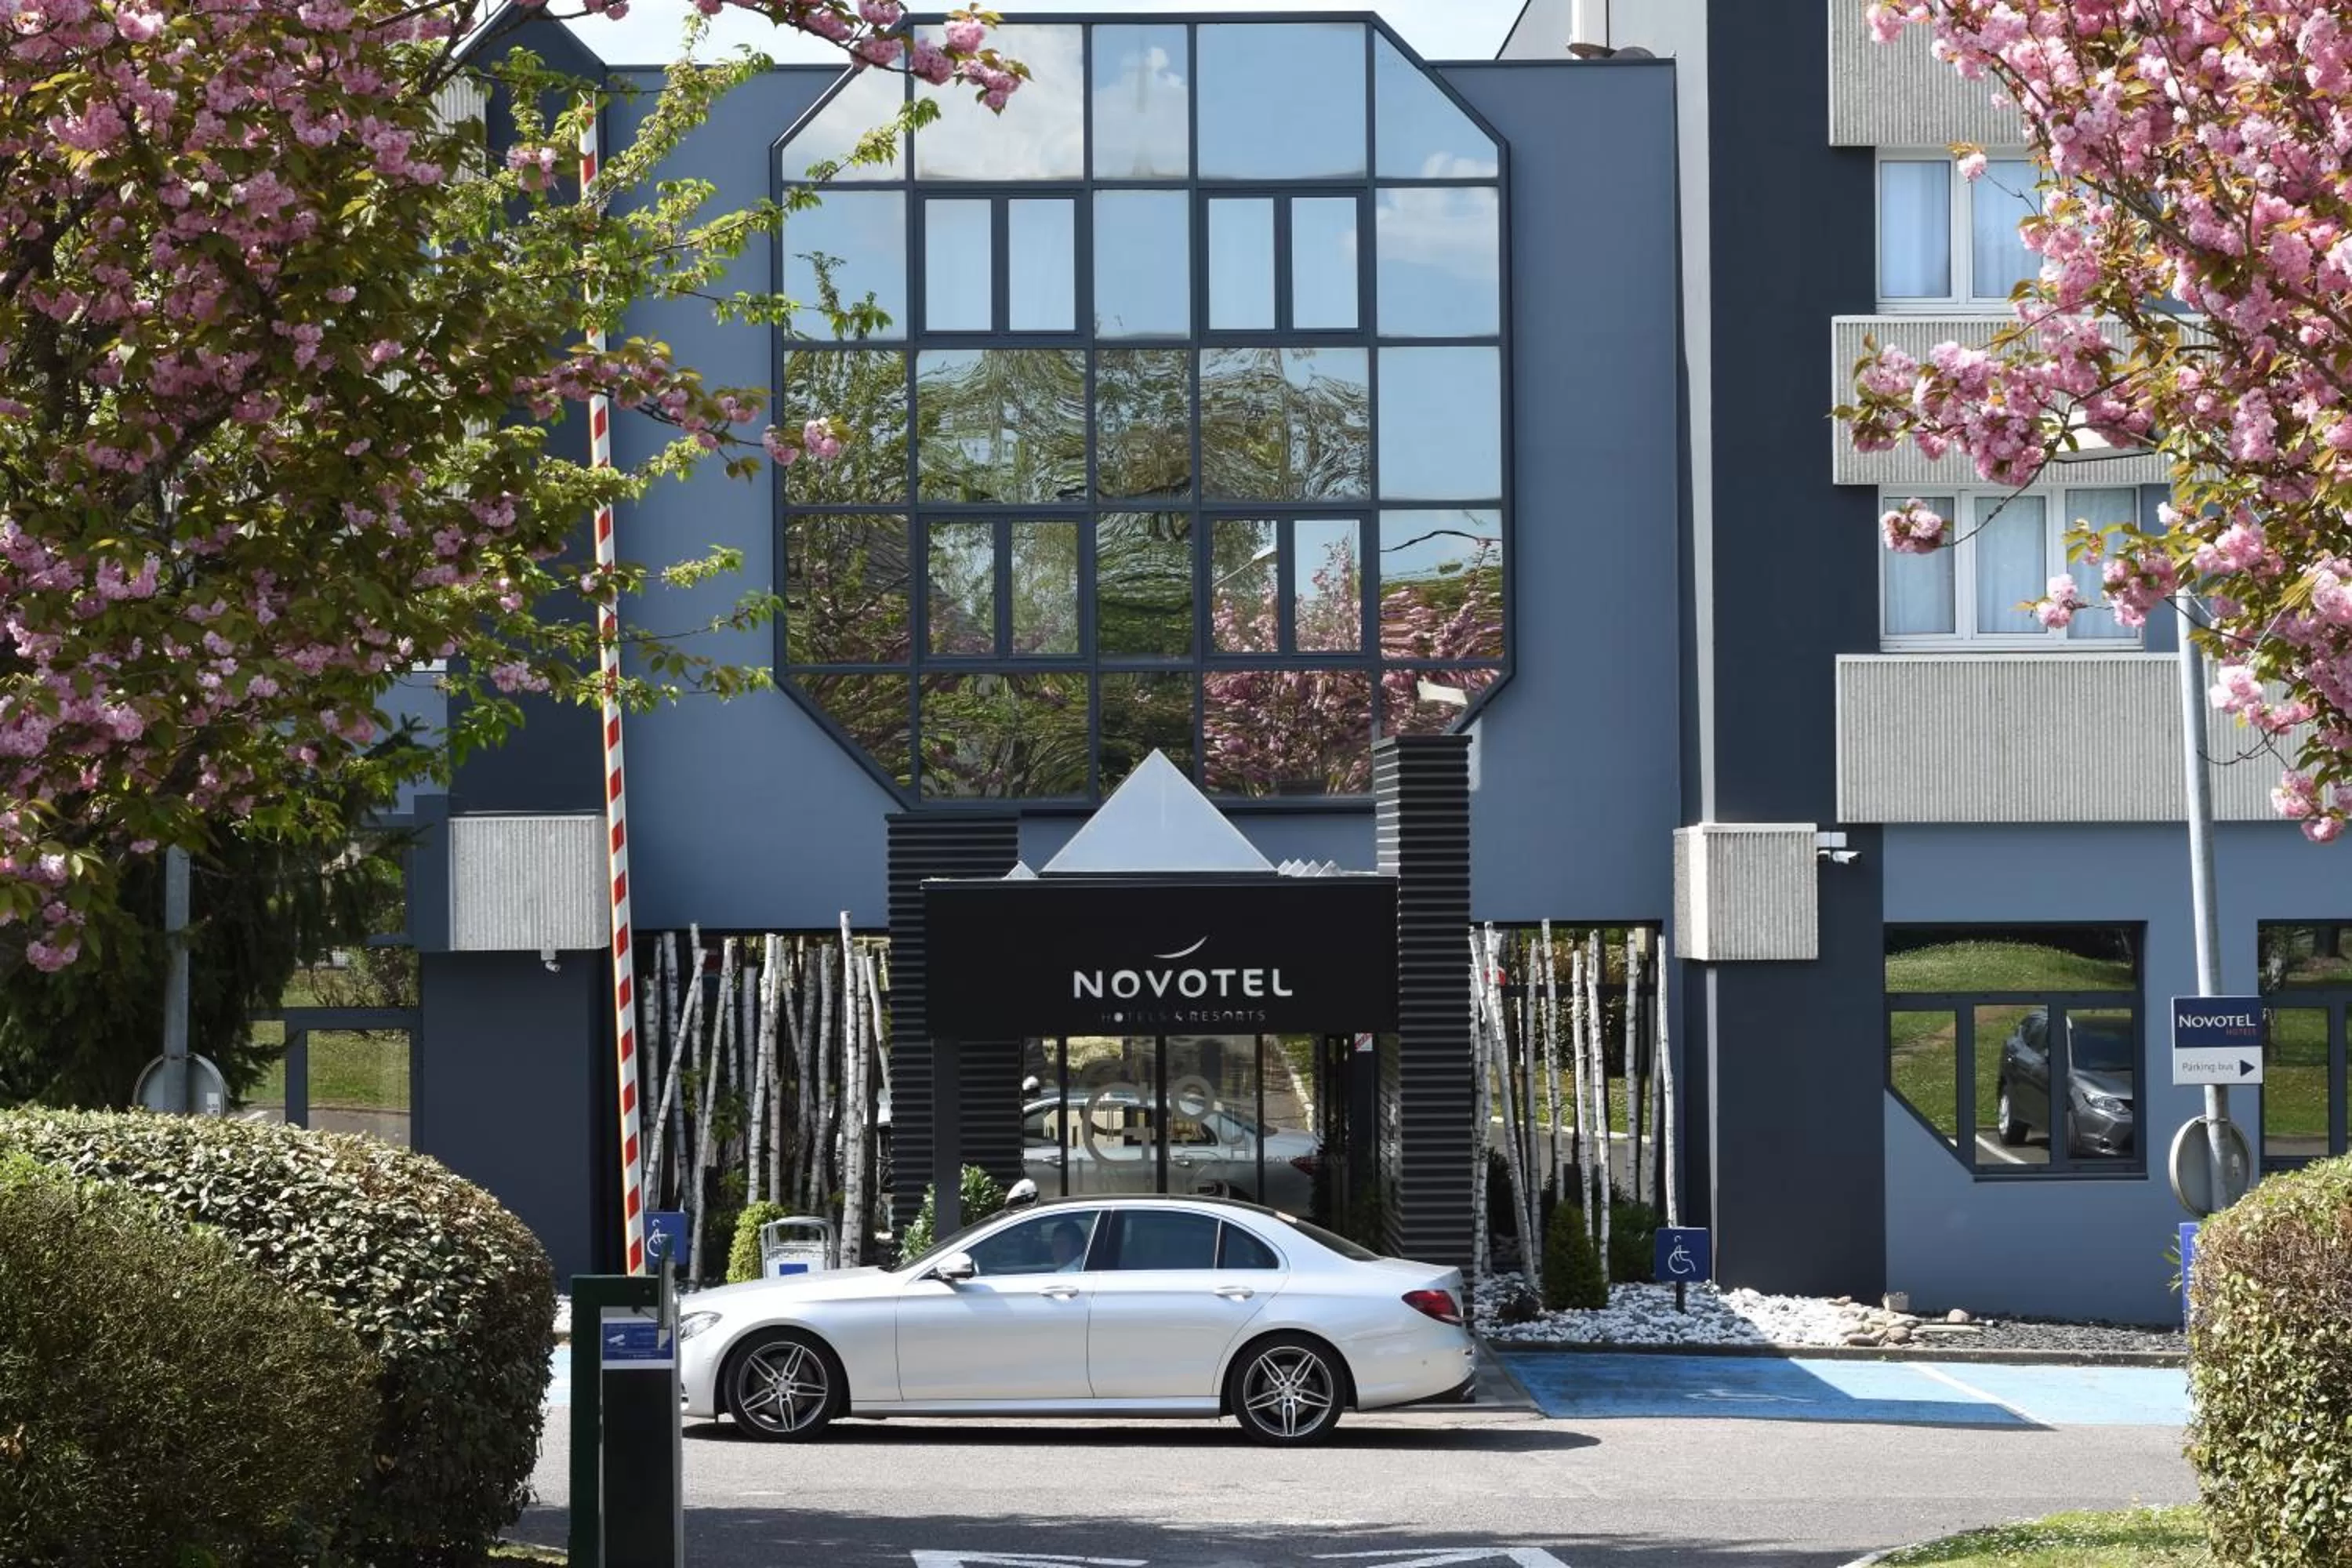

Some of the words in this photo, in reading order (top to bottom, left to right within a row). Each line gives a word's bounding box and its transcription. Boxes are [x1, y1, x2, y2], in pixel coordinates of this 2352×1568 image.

[1073, 968, 1293, 999] NOVOTEL
[2179, 1013, 2256, 1028] NOVOTEL
[2182, 1062, 2215, 1073] Parking
[2218, 1062, 2234, 1071] bus
